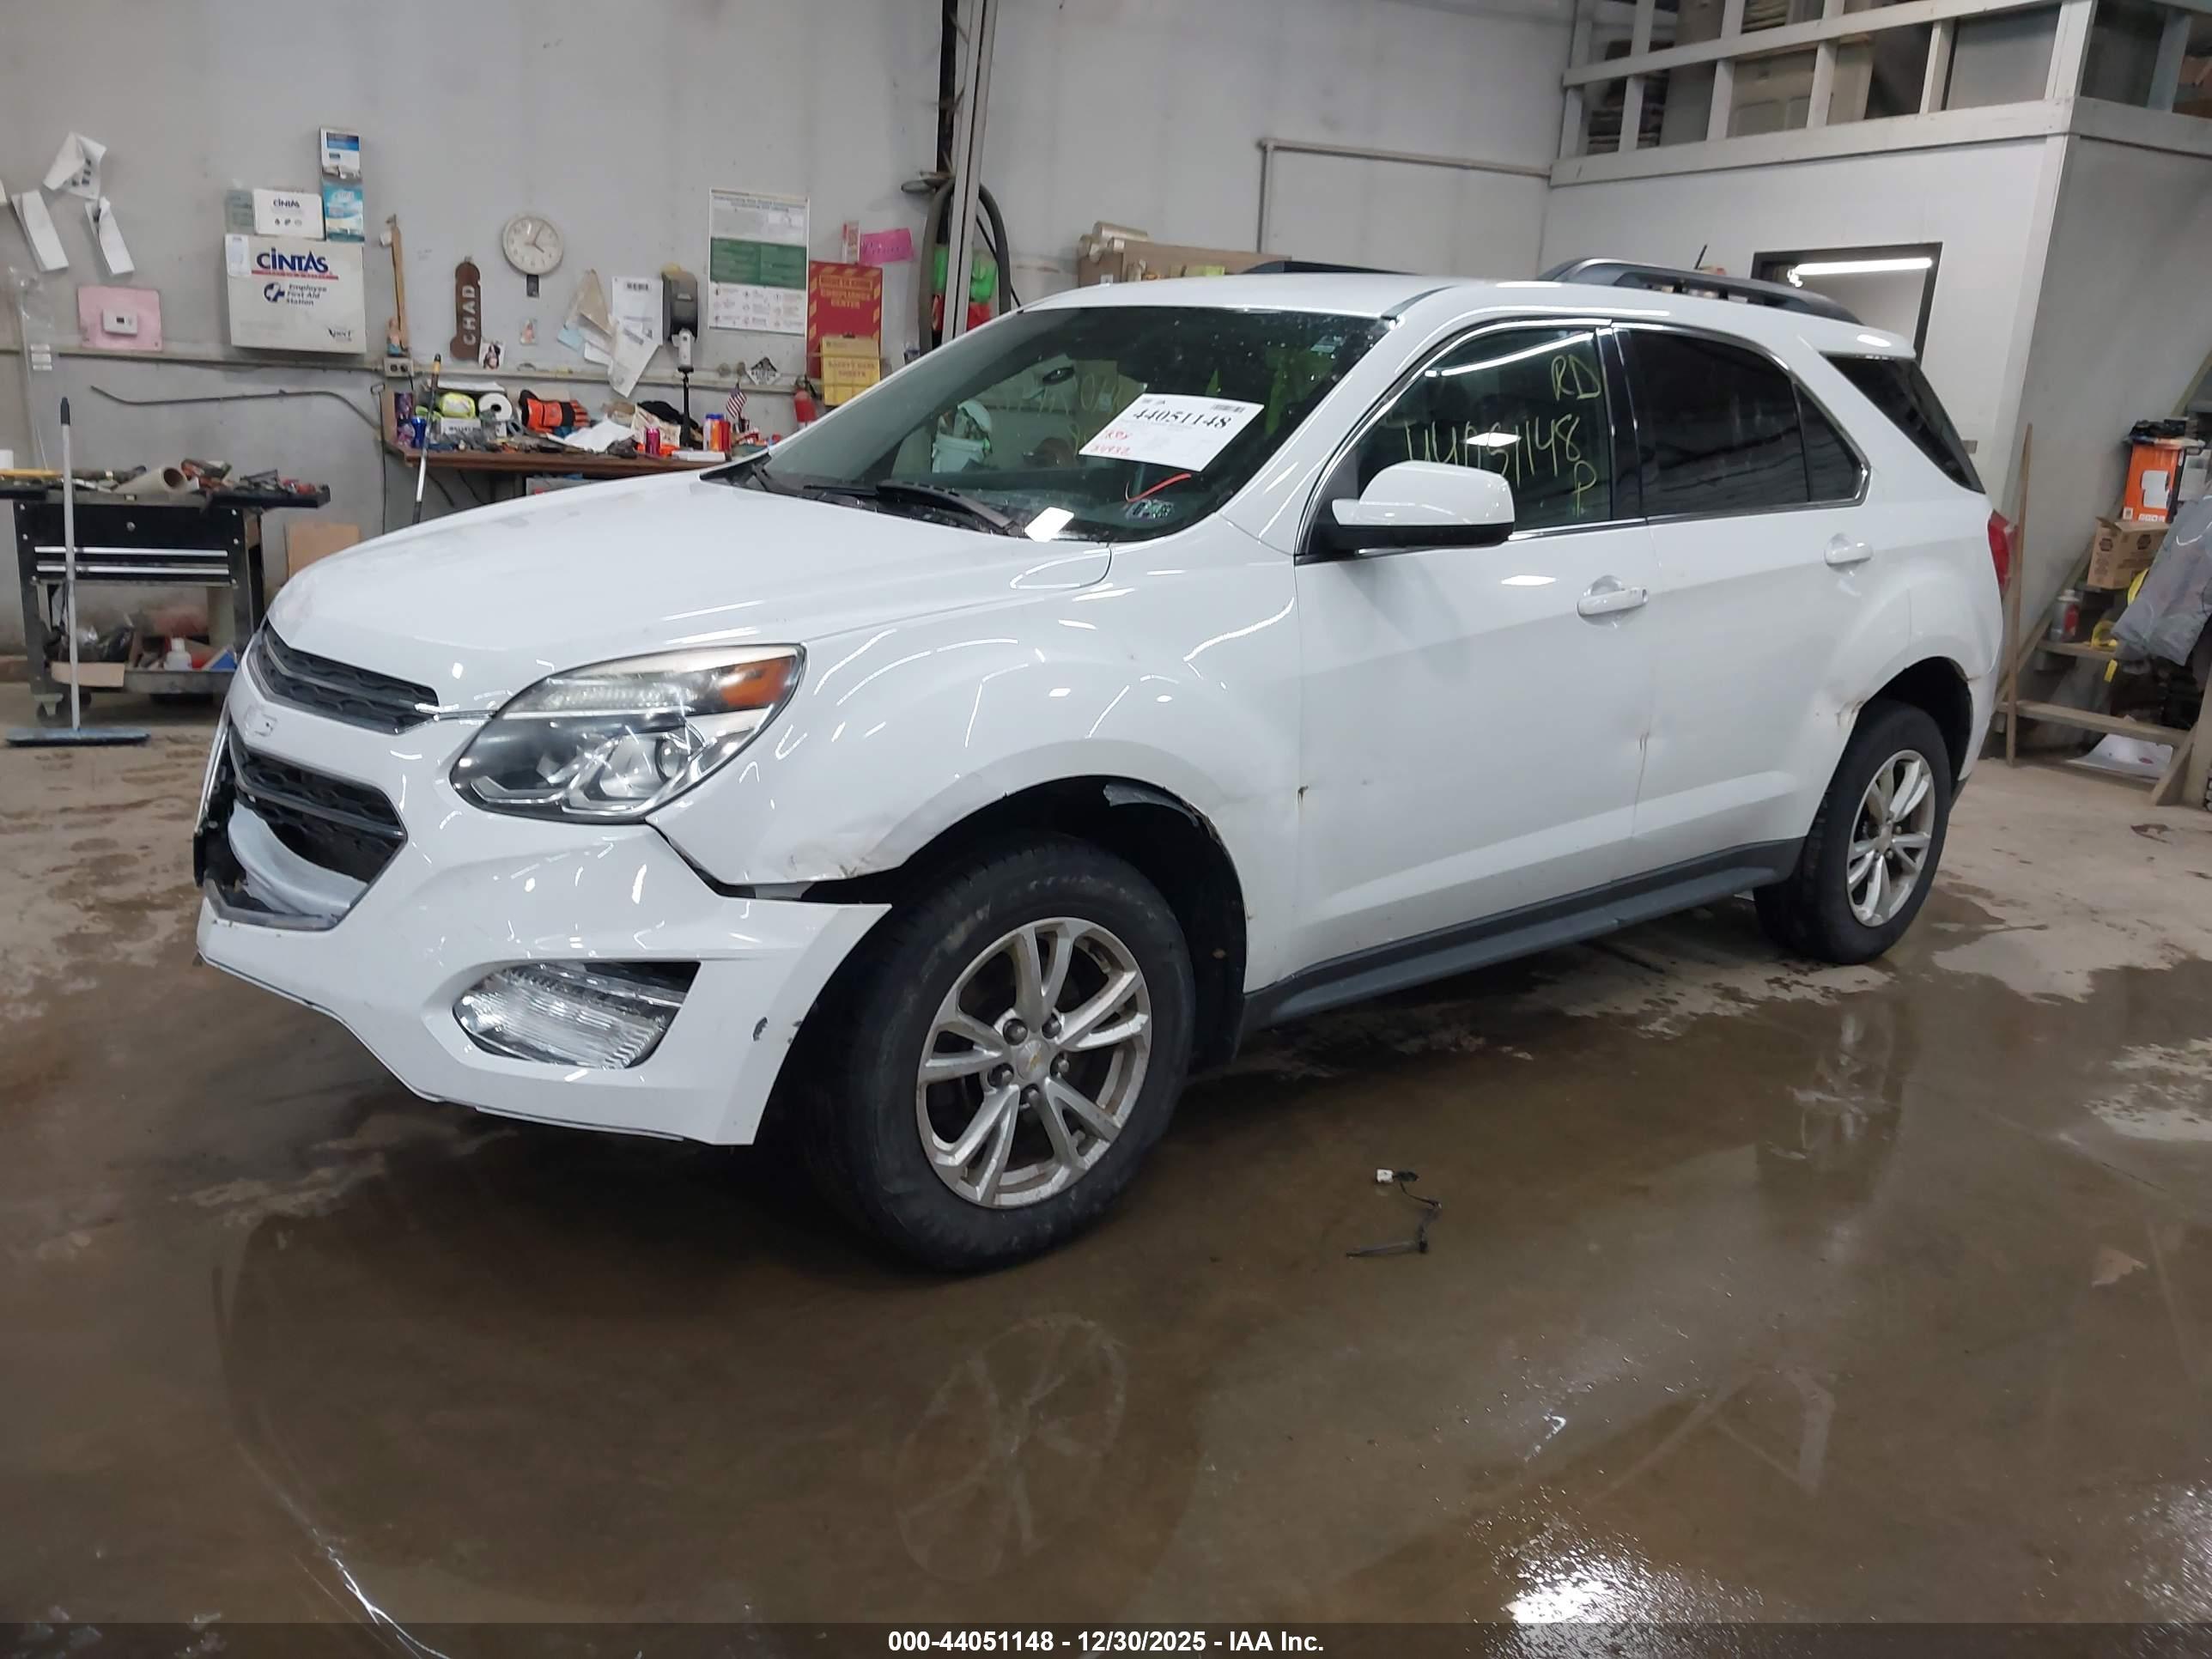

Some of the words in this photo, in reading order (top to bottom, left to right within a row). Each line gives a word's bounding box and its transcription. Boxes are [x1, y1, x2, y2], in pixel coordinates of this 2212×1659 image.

[257, 247, 329, 273] CINTAS
[289, 283, 327, 293] Employee
[462, 285, 477, 345] CHAD
[1552, 354, 1601, 401] RD
[1133, 408, 1231, 428] 44051148
